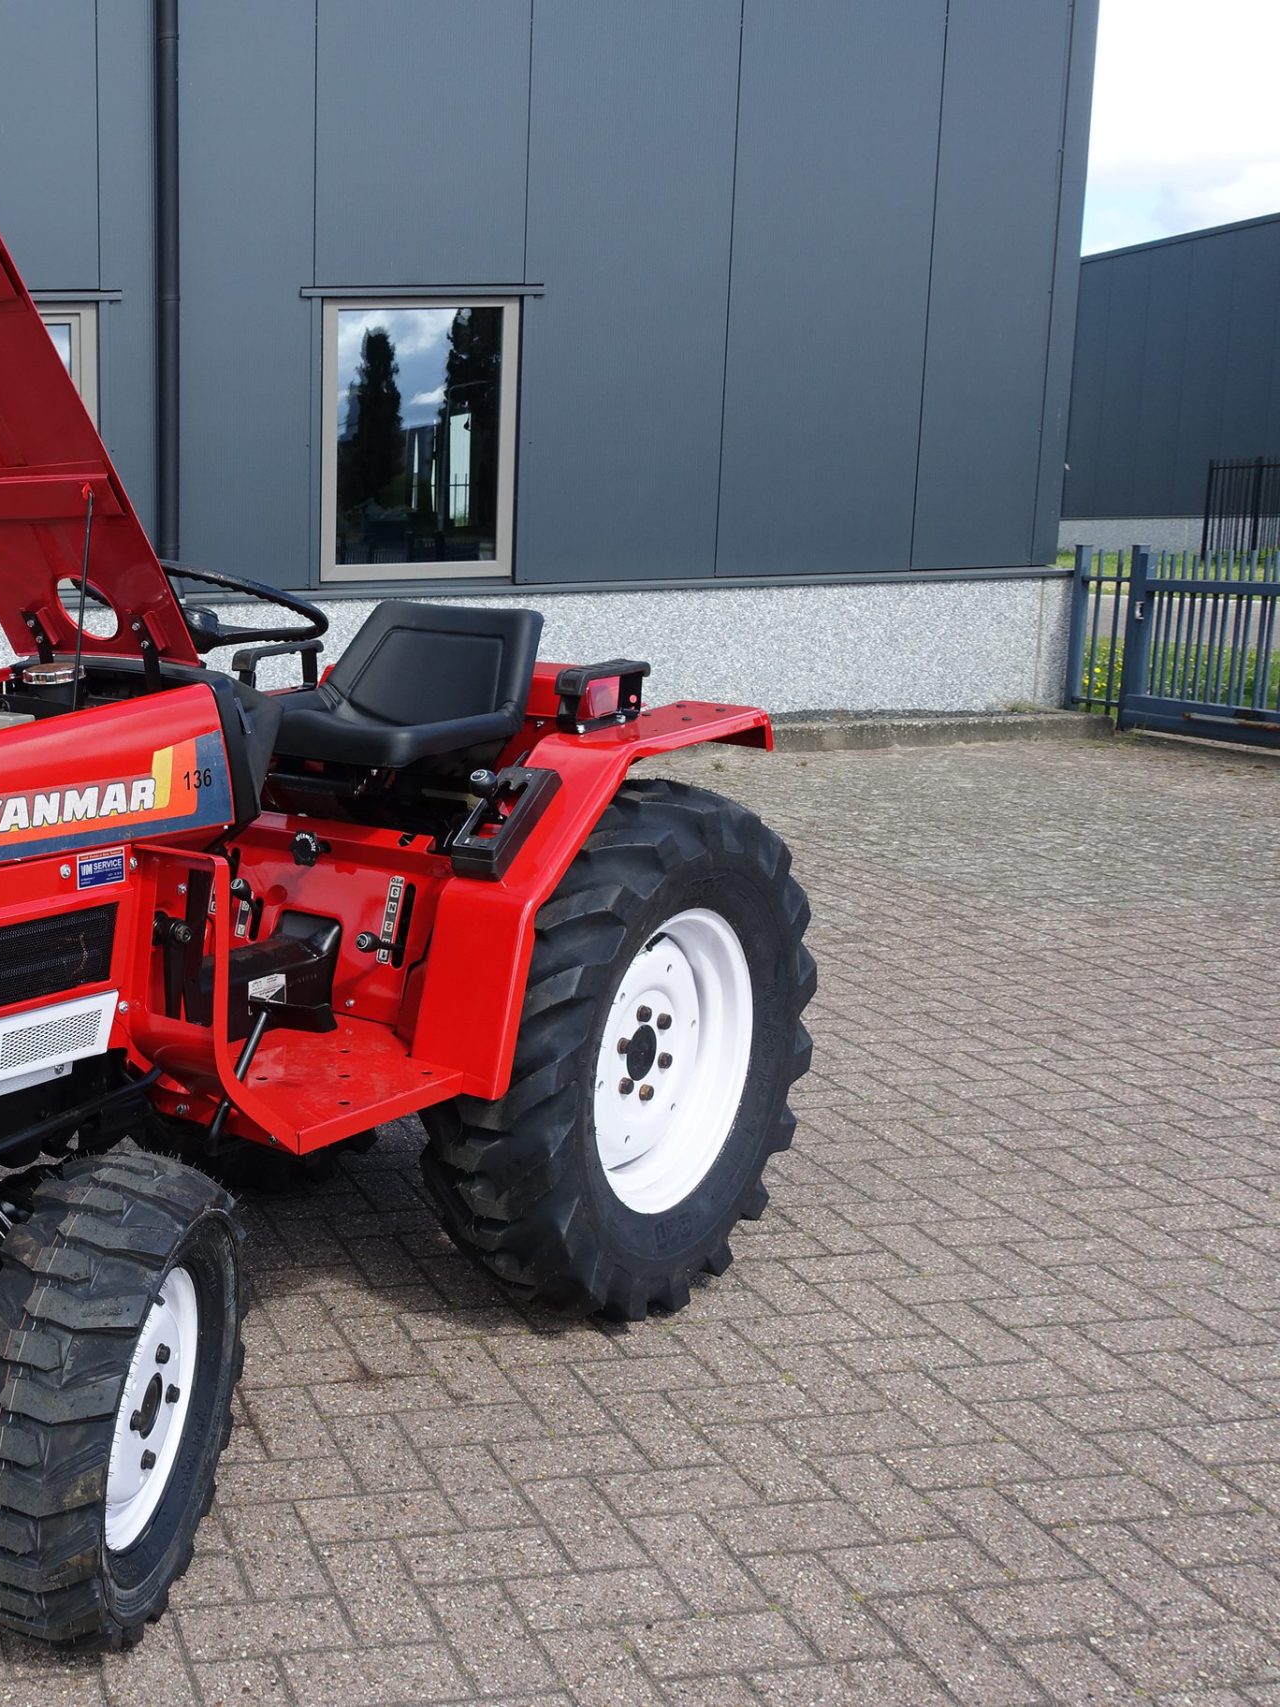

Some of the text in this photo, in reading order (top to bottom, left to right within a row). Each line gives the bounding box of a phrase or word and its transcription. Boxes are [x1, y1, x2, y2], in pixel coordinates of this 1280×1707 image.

[183, 767, 212, 791] 136
[93, 858, 122, 871] SERVICE
[392, 888, 399, 896] 3
[389, 903, 396, 912] N
[385, 922, 392, 930] 2
